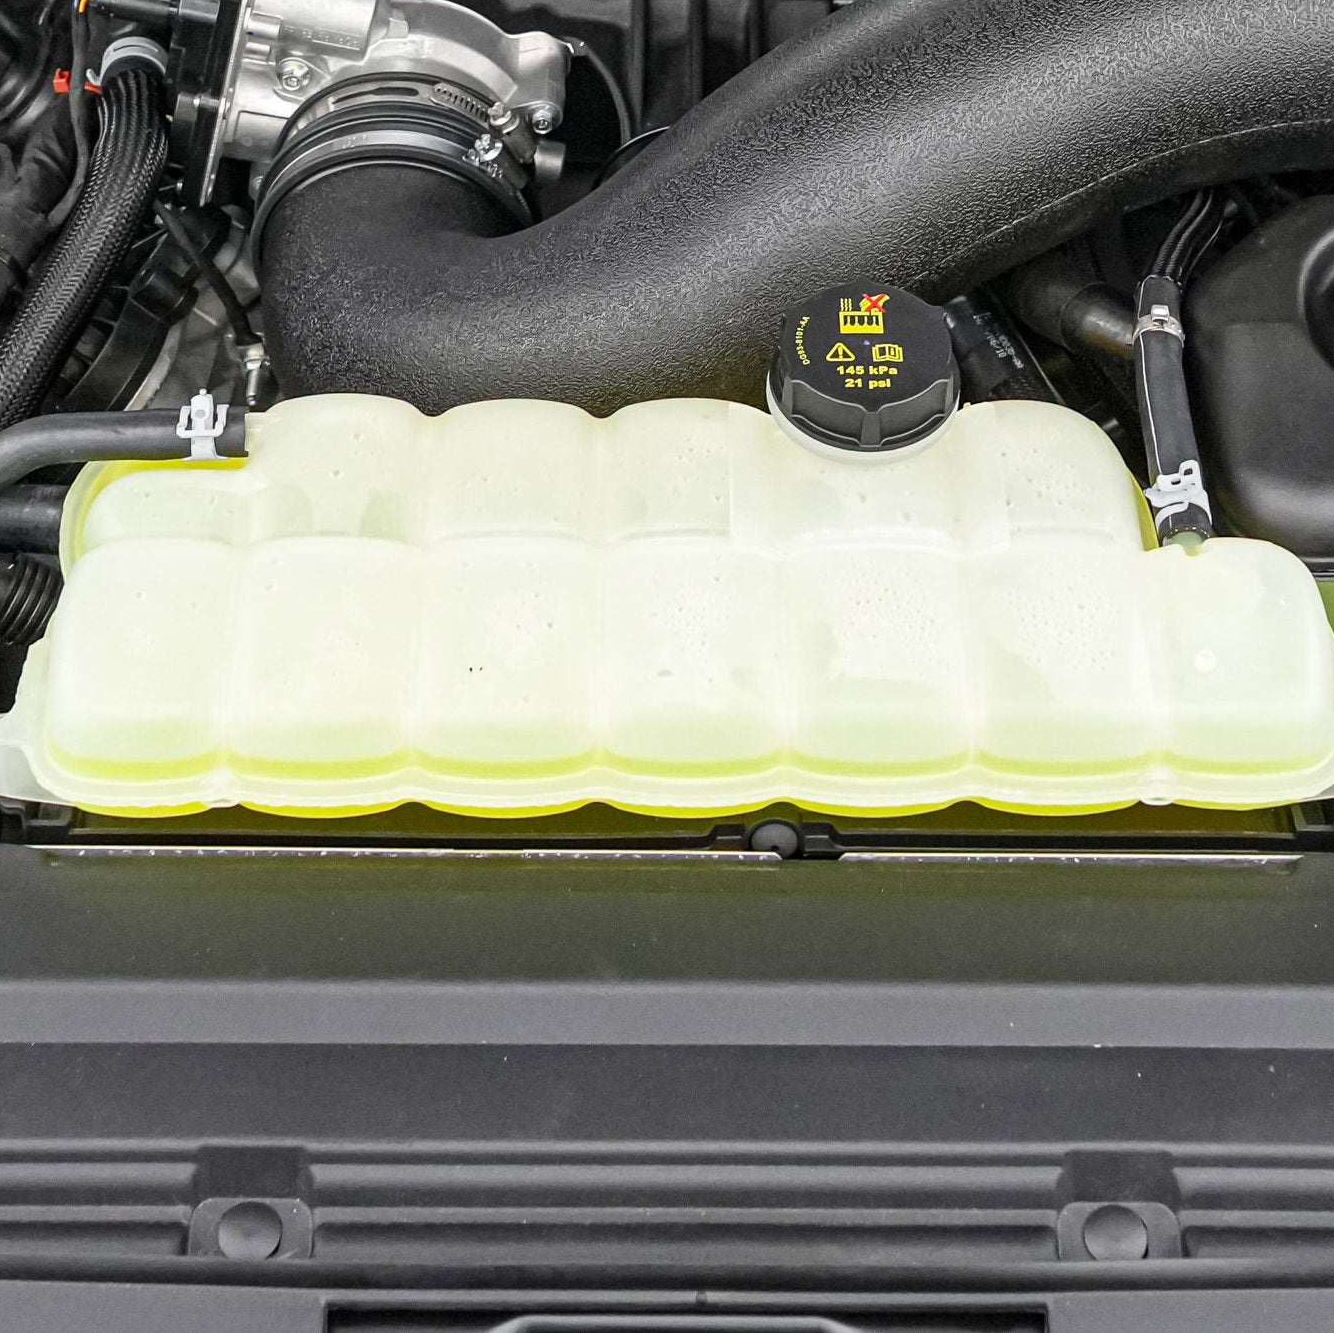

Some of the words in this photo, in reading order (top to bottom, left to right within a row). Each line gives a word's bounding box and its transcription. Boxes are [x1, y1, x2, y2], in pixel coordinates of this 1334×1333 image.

[836, 366, 865, 375] 145
[869, 365, 898, 375] kPa
[845, 378, 863, 388] 21
[869, 378, 892, 389] psi
